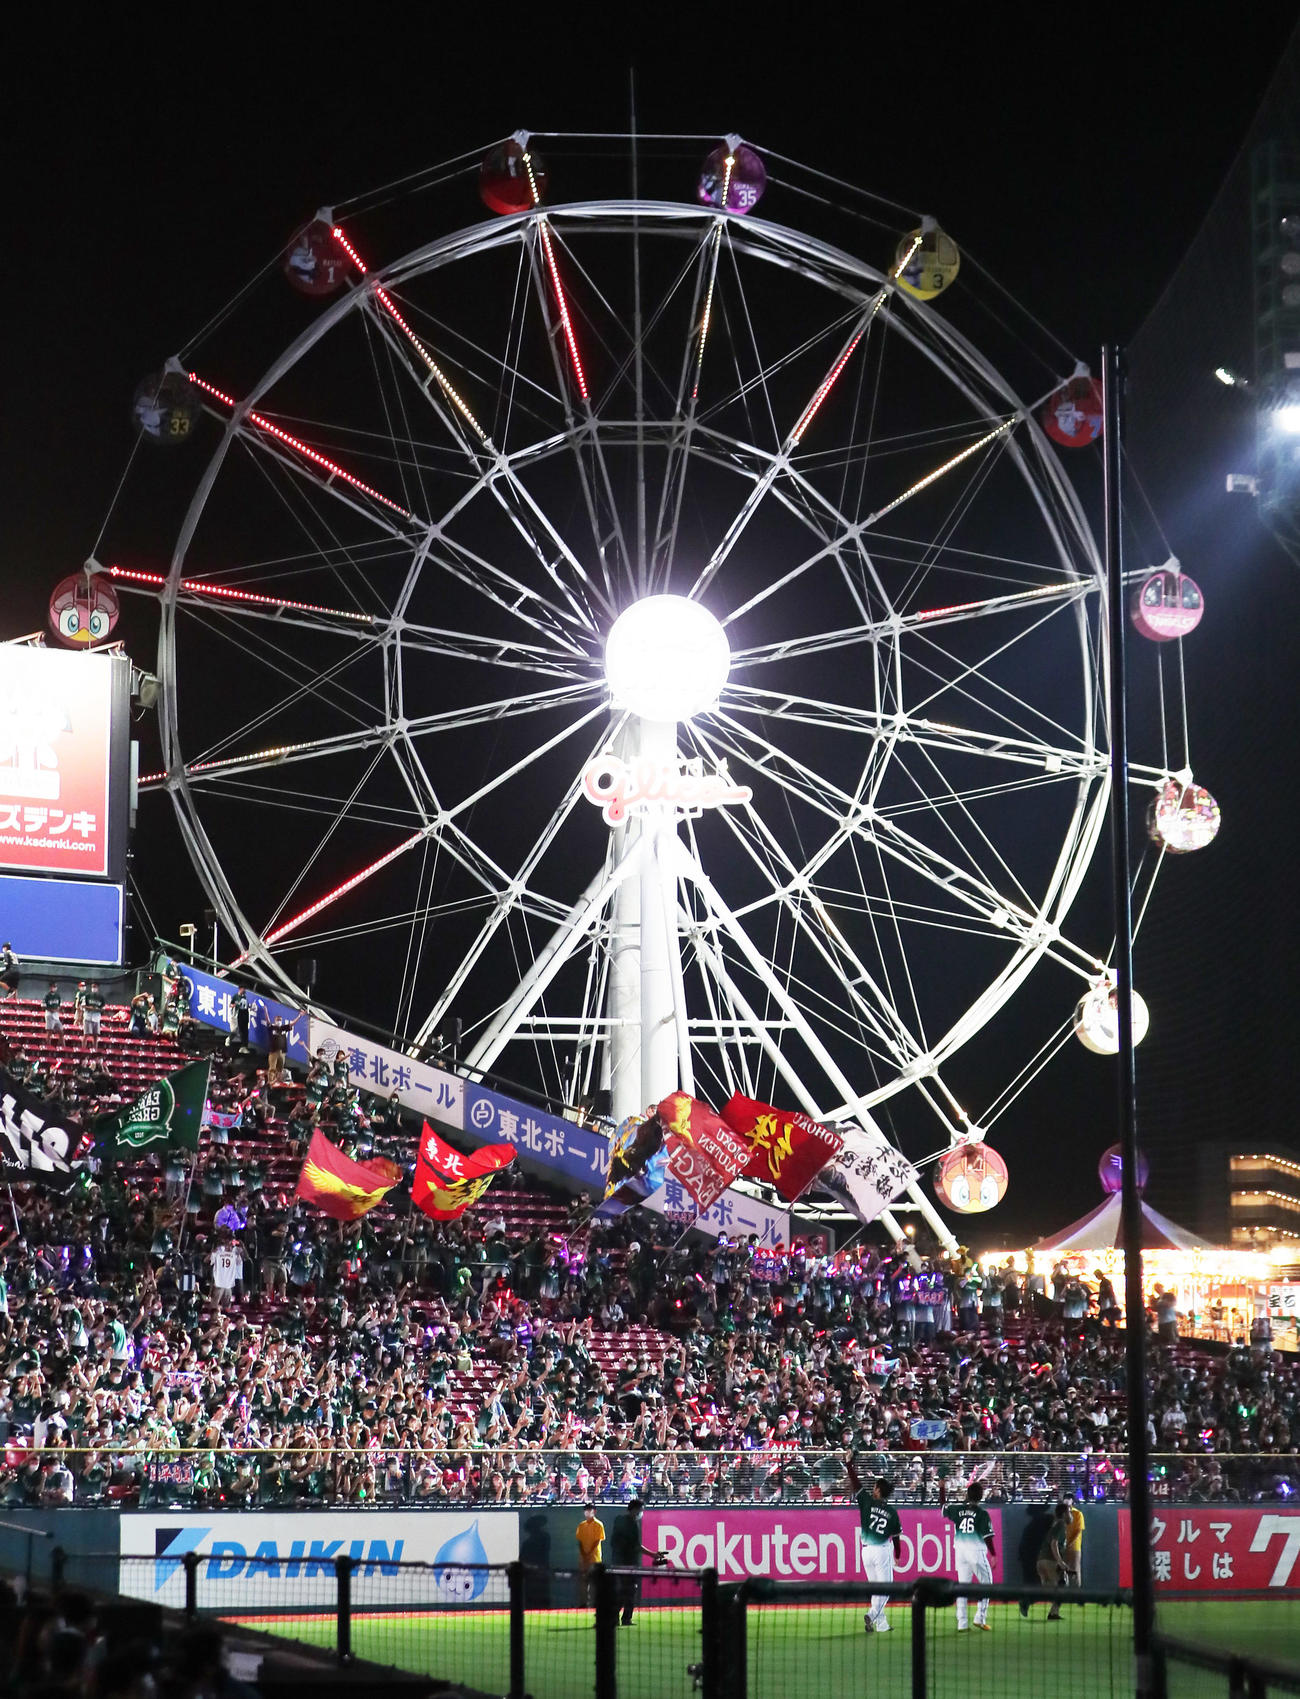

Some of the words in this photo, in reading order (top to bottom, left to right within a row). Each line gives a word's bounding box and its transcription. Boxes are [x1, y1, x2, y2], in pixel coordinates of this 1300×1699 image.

[738, 190, 757, 206] 35
[934, 273, 944, 288] 3
[170, 418, 190, 435] 33
[0, 804, 96, 838] ズデンキ
[347, 1047, 456, 1109] 東北ポール
[425, 1137, 464, 1176] 東北
[498, 1109, 610, 1175] 東北ポール
[221, 1258, 231, 1268] 19
[868, 1514, 888, 1534] 72
[959, 1517, 975, 1533] 46
[1151, 1516, 1233, 1545] クルマ
[205, 1539, 404, 1579] DAIKIN
[658, 1521, 848, 1574] Rakuten
[1153, 1551, 1234, 1582] 探しは
